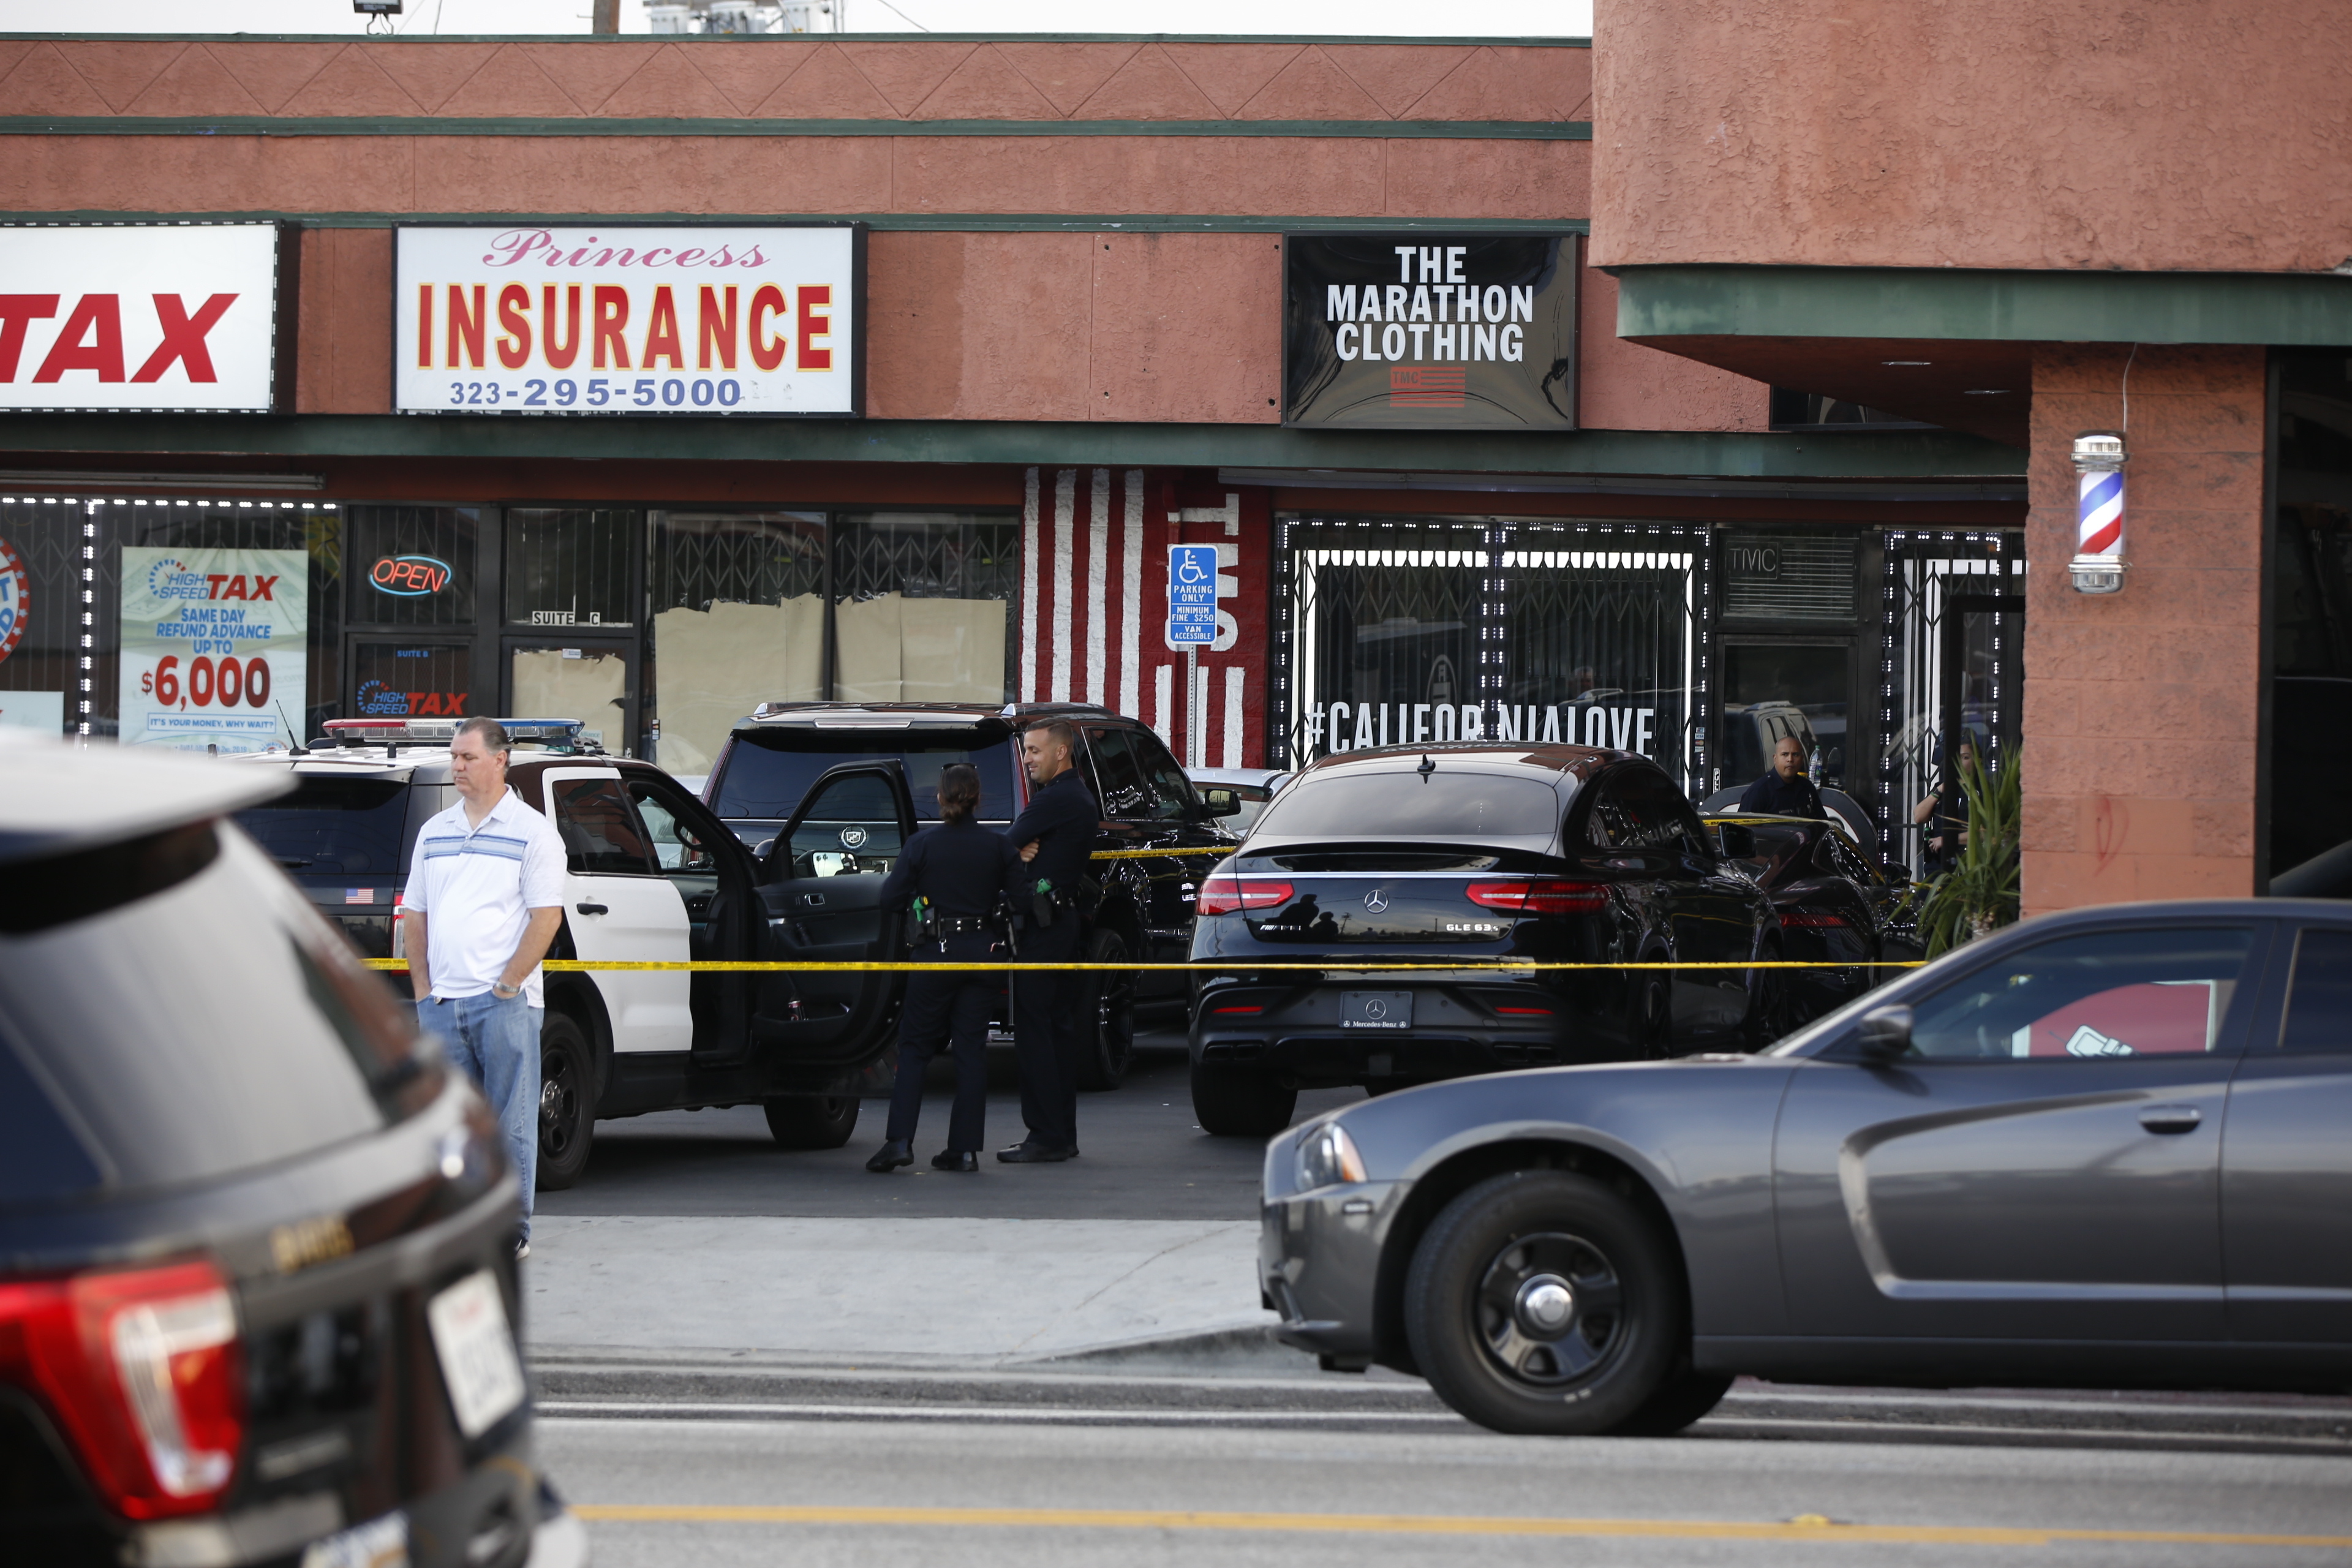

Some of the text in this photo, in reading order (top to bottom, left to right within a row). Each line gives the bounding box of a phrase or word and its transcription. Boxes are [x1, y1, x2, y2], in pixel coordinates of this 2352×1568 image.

[482, 228, 771, 268] Princess
[1395, 246, 1466, 283] THE
[1327, 285, 1533, 323] MARATHON
[417, 281, 833, 372] INSURANCE
[0, 293, 241, 383] TAX
[1336, 323, 1523, 361] CLOTHING
[1393, 371, 1419, 383] TMC
[450, 379, 741, 406] 323-295-5000
[1729, 548, 1776, 571] TMC
[168, 573, 206, 586] HIGH
[374, 559, 446, 592] OPEN
[159, 586, 209, 600] SPEED
[207, 575, 279, 601] TAX
[1174, 585, 1213, 594] PARKING
[1182, 594, 1204, 602] ONLY
[181, 608, 246, 623] SAME DAY
[533, 612, 598, 625] SUITE C
[1194, 614, 1214, 622] $250
[156, 623, 271, 639] REFUND ADVANCE
[193, 639, 233, 654] UP TO
[141, 655, 271, 712] $6,000
[374, 692, 406, 703] HIGH
[406, 692, 468, 715] TAX
[366, 703, 409, 714] SPEED
